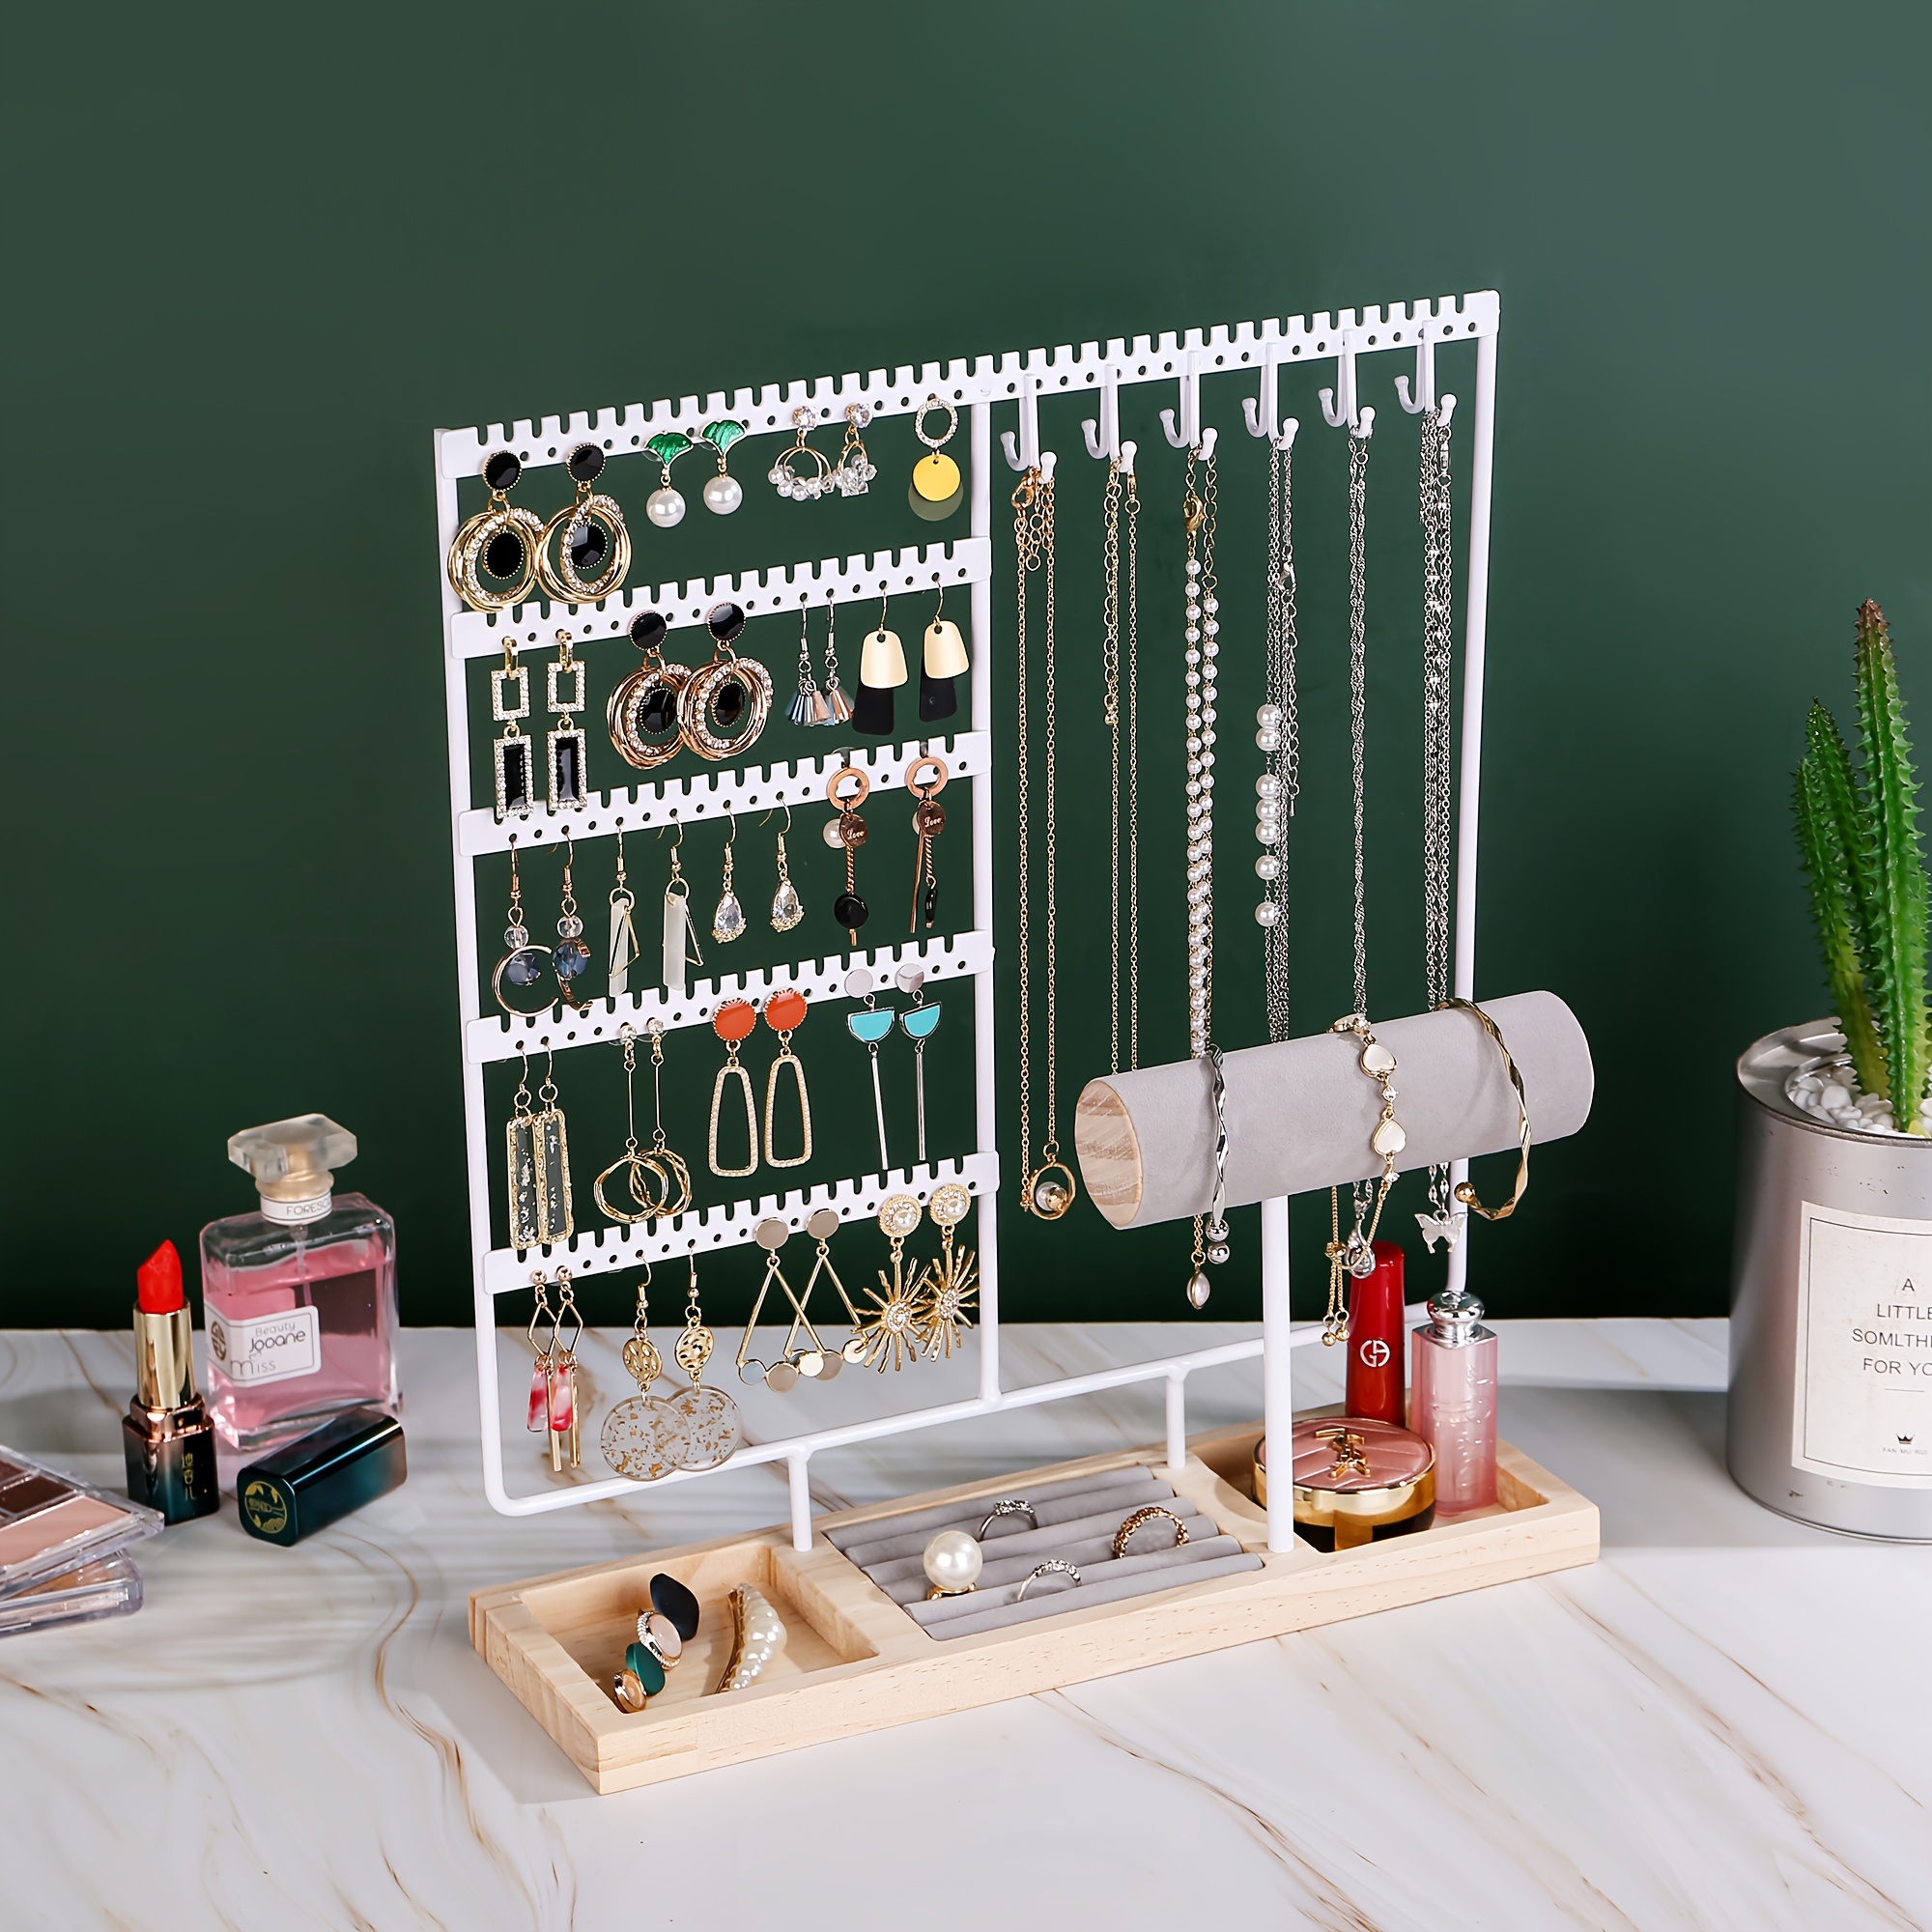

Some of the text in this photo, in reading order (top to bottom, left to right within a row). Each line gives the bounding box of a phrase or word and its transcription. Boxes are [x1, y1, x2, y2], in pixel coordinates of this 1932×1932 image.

[1901, 1278, 1915, 1292] A
[255, 1321, 296, 1337] Beauty
[1862, 1357, 1901, 1375] FOR
